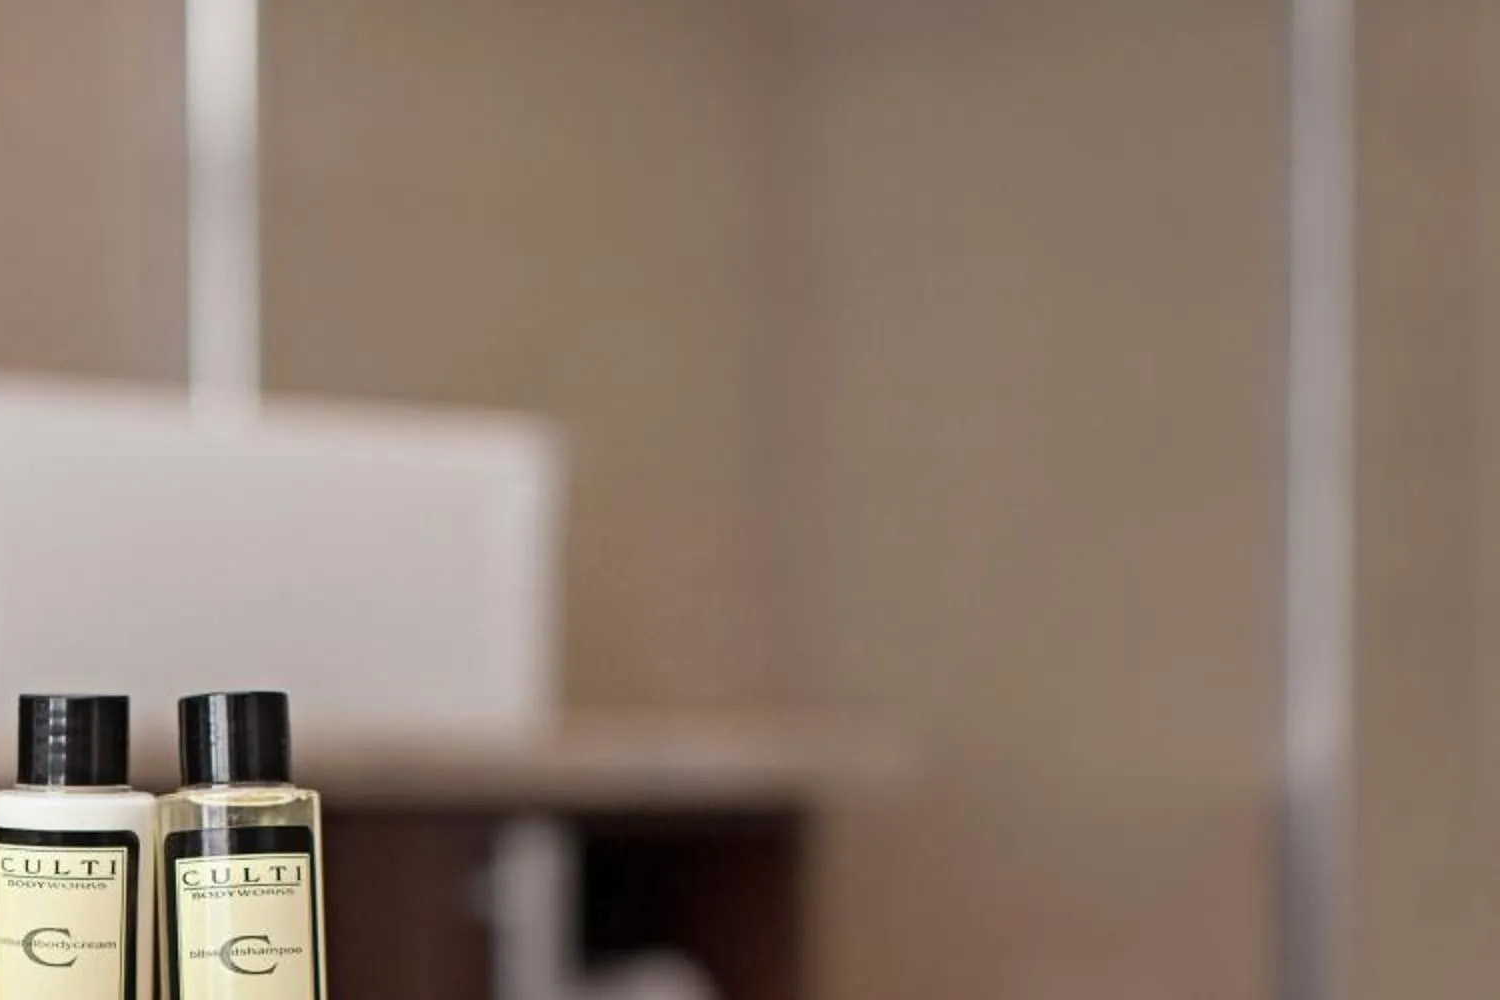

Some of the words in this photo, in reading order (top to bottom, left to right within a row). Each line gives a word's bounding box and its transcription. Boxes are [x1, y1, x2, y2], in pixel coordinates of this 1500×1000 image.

[1, 857, 117, 876] CULTI
[182, 865, 302, 887] CULTI
[7, 879, 108, 890] BODYWORKS
[191, 887, 295, 900] BODYWORKS
[22, 927, 78, 968] C
[220, 935, 278, 976] C
